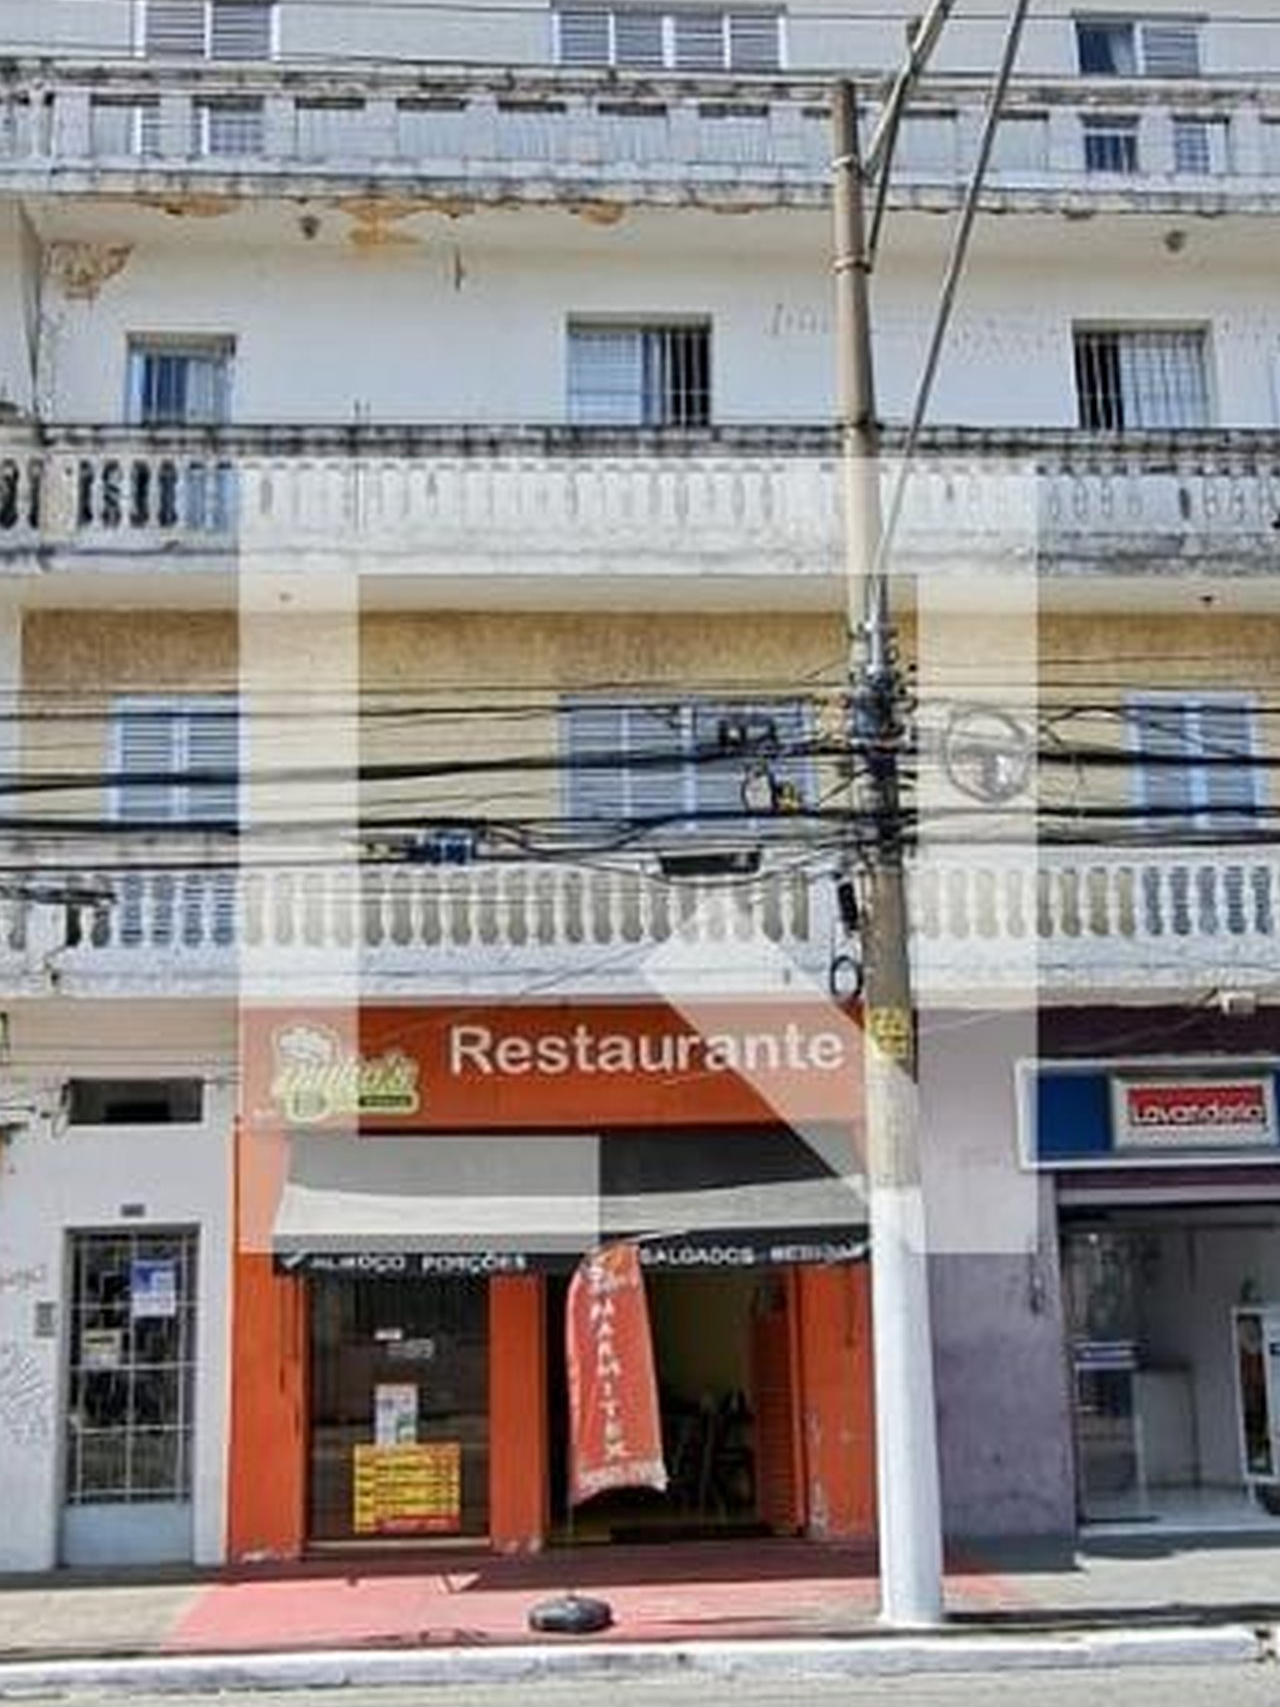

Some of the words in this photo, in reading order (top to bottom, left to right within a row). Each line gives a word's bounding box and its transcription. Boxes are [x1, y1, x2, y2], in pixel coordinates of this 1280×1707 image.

[449, 1024, 845, 1074] Restaurante
[1133, 1100, 1265, 1124] Lavanderia
[639, 1246, 756, 1265] SALGADOS
